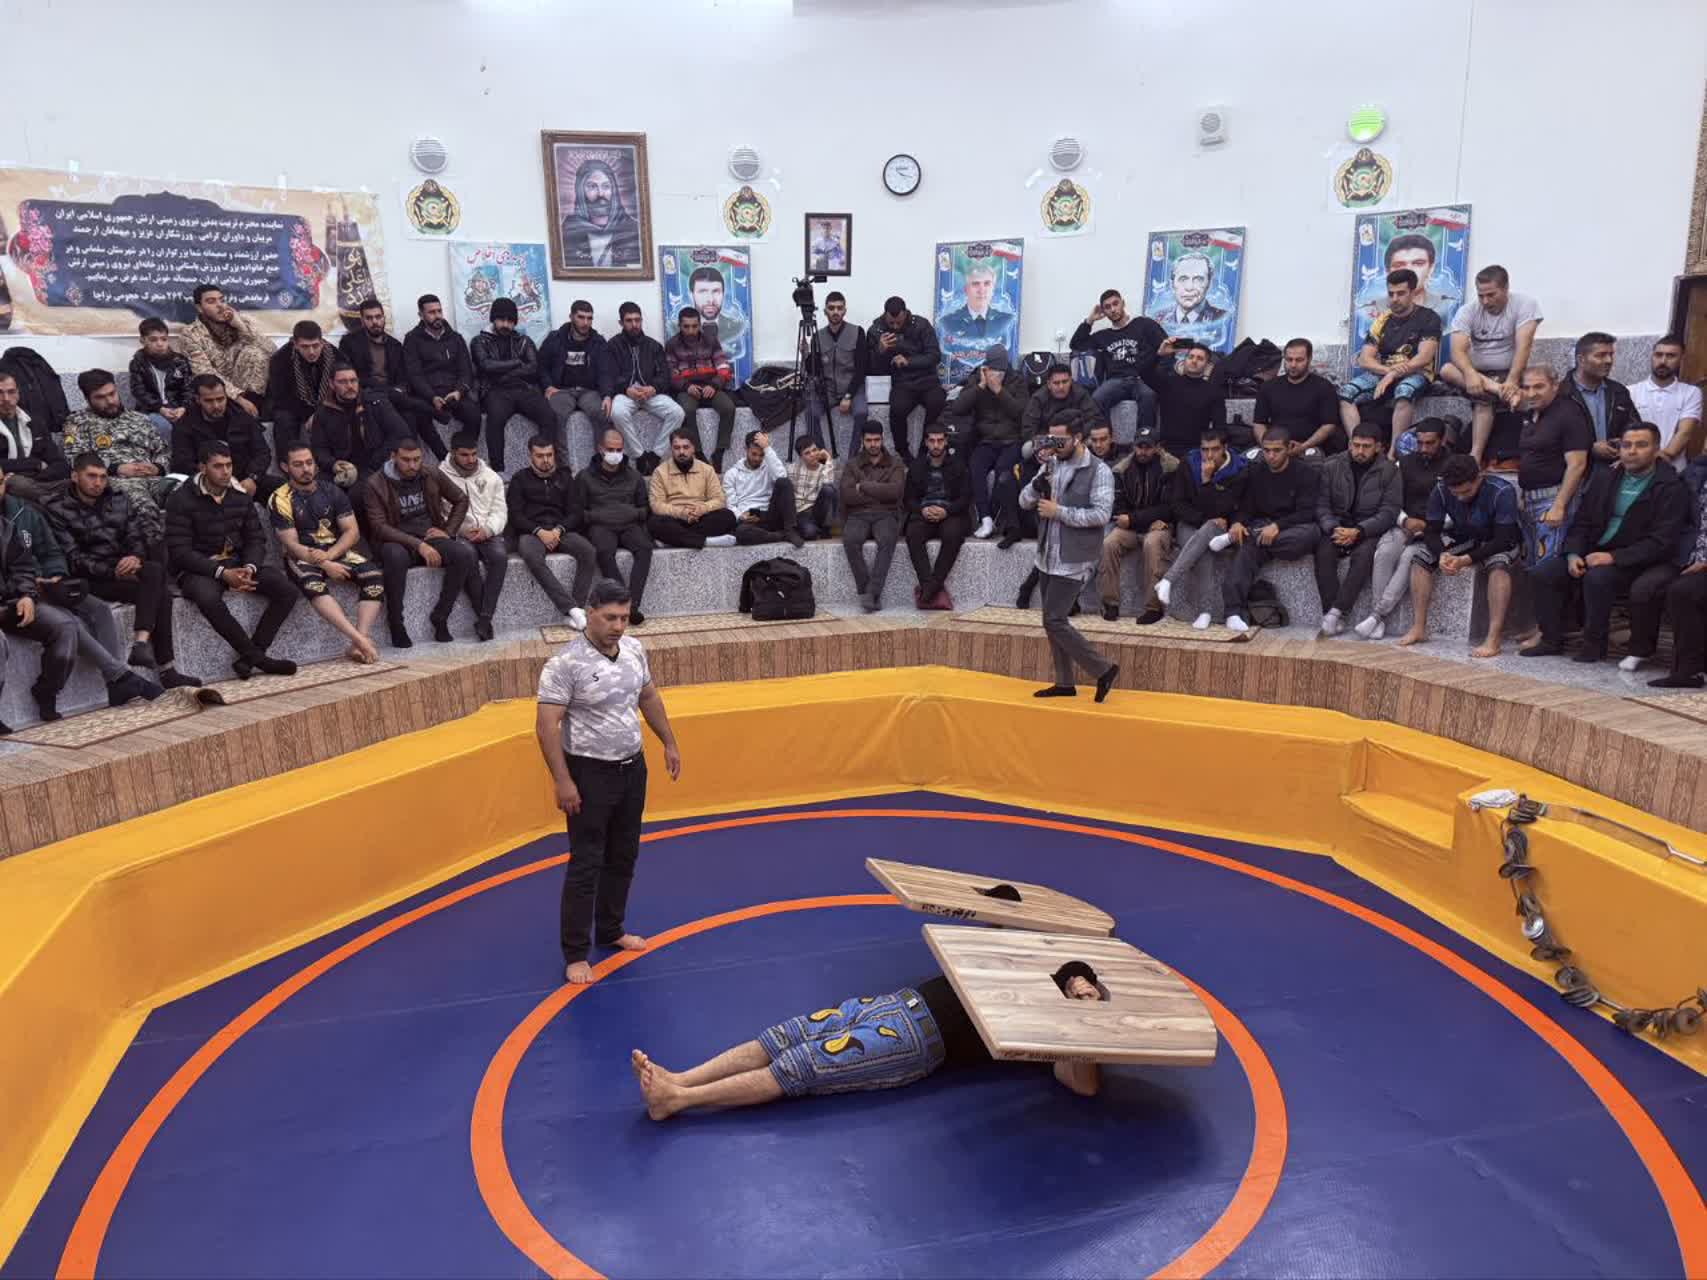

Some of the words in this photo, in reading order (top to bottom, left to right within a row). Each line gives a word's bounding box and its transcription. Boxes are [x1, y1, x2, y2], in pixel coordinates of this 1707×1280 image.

[55, 207, 75, 219] ایران
[76, 209, 103, 221] اسلامی
[103, 213, 134, 223] جمهوری
[135, 214, 155, 225] ارتش
[106, 244, 137, 256] شهرستان
[220, 275, 242, 285] اسلامی
[244, 277, 269, 287] جمهوری
